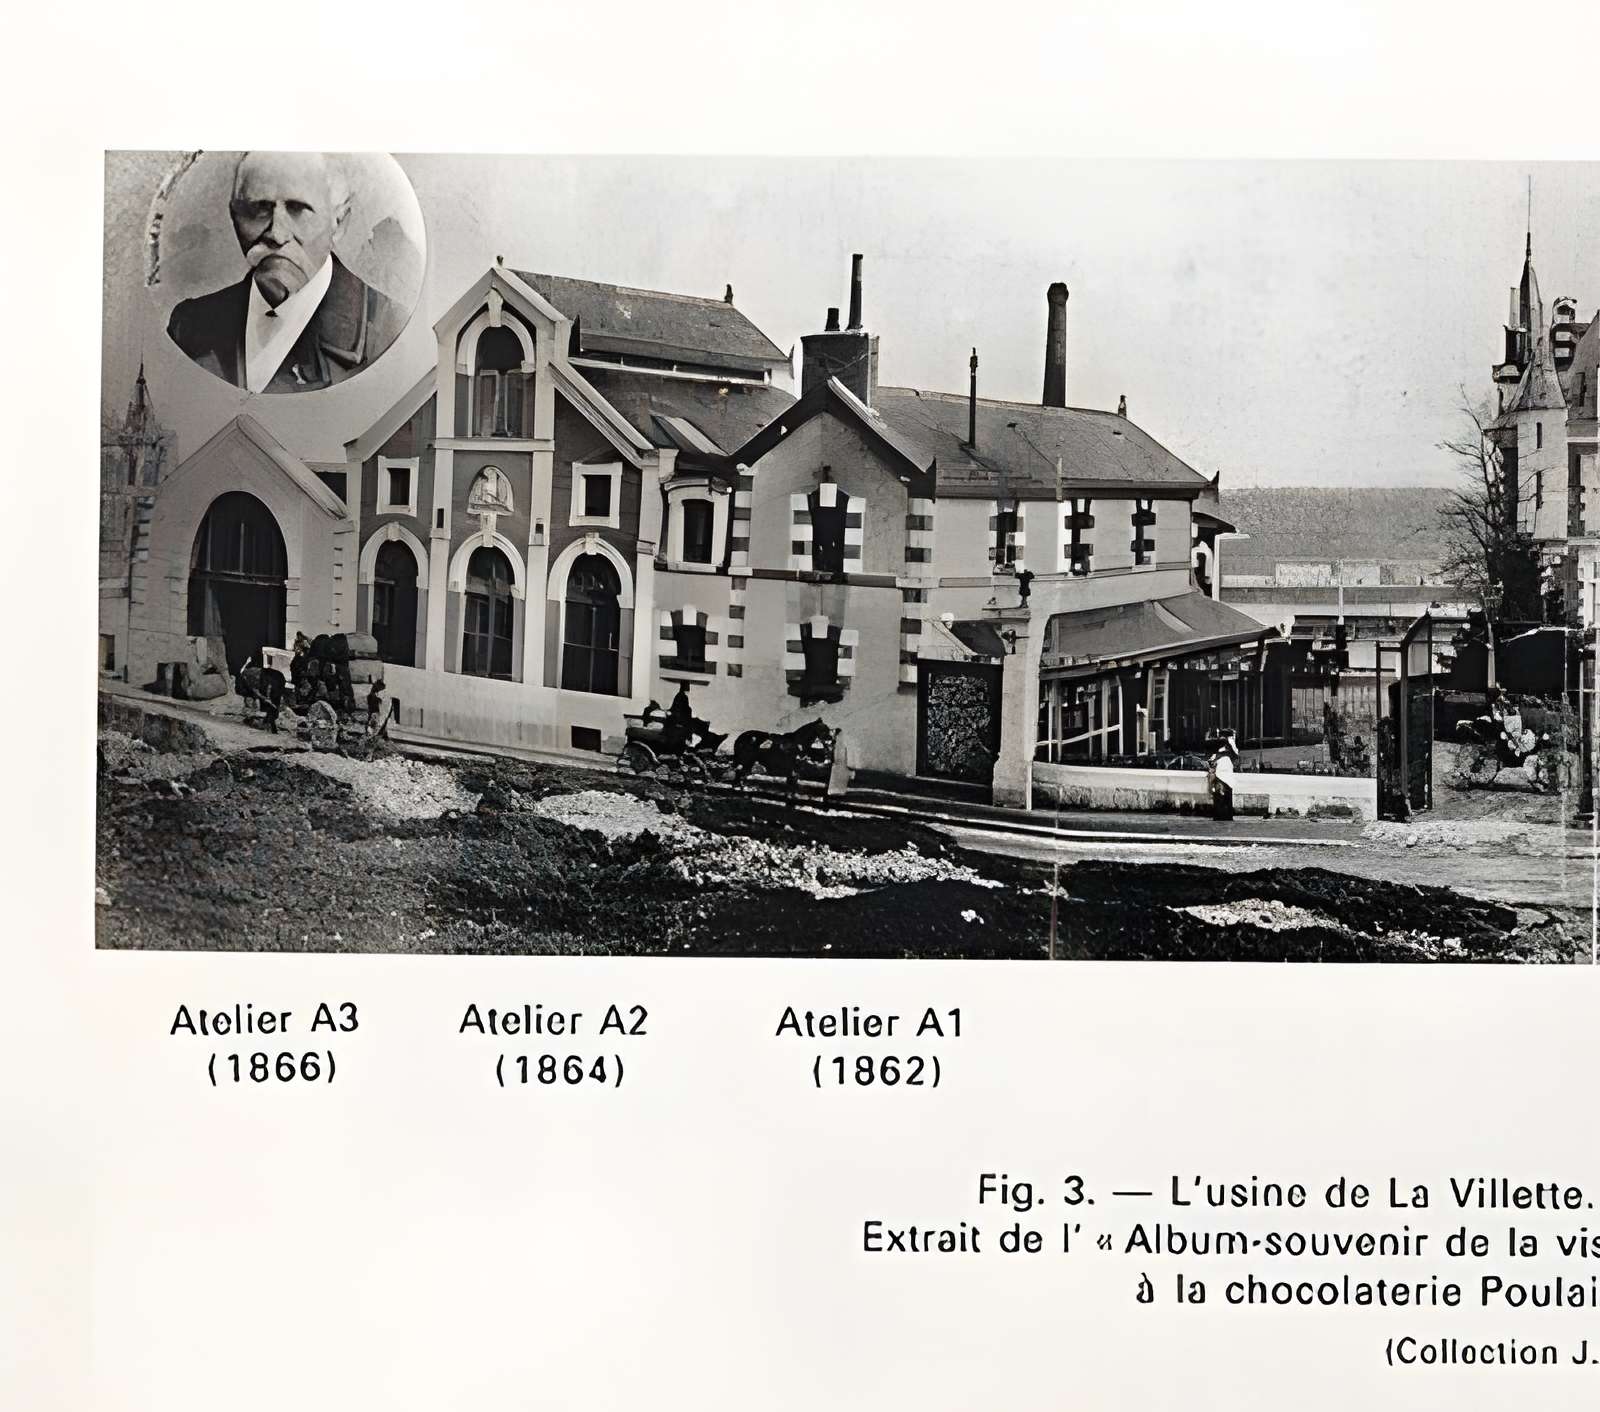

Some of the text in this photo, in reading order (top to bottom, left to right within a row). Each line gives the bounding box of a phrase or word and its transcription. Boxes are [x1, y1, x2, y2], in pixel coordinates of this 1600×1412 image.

[169, 1001, 359, 1036] Atelier A3
[459, 1003, 648, 1036] Atelier A2
[775, 1006, 961, 1038] Atelier A1
[208, 1050, 336, 1087] (1866)
[496, 1054, 624, 1088] (1864)
[813, 1055, 941, 1089] (1862)
[979, 1173, 1045, 1213] Fig.
[1063, 1175, 1095, 1206] 3.
[1172, 1175, 1307, 1208] L'usine
[1325, 1176, 1370, 1209] de
[1389, 1177, 1429, 1209] La
[1449, 1177, 1593, 1210] Villette.
[863, 1220, 981, 1253] Extrait
[999, 1222, 1043, 1254] de
[1124, 1223, 1429, 1257] Album-souvenir
[1445, 1226, 1489, 1257] de
[1509, 1227, 1538, 1258] la
[1136, 1272, 1154, 1304] à
[1177, 1273, 1206, 1304] la
[1225, 1273, 1461, 1307] chocolaterie
[1385, 1336, 1558, 1367] (Collection
